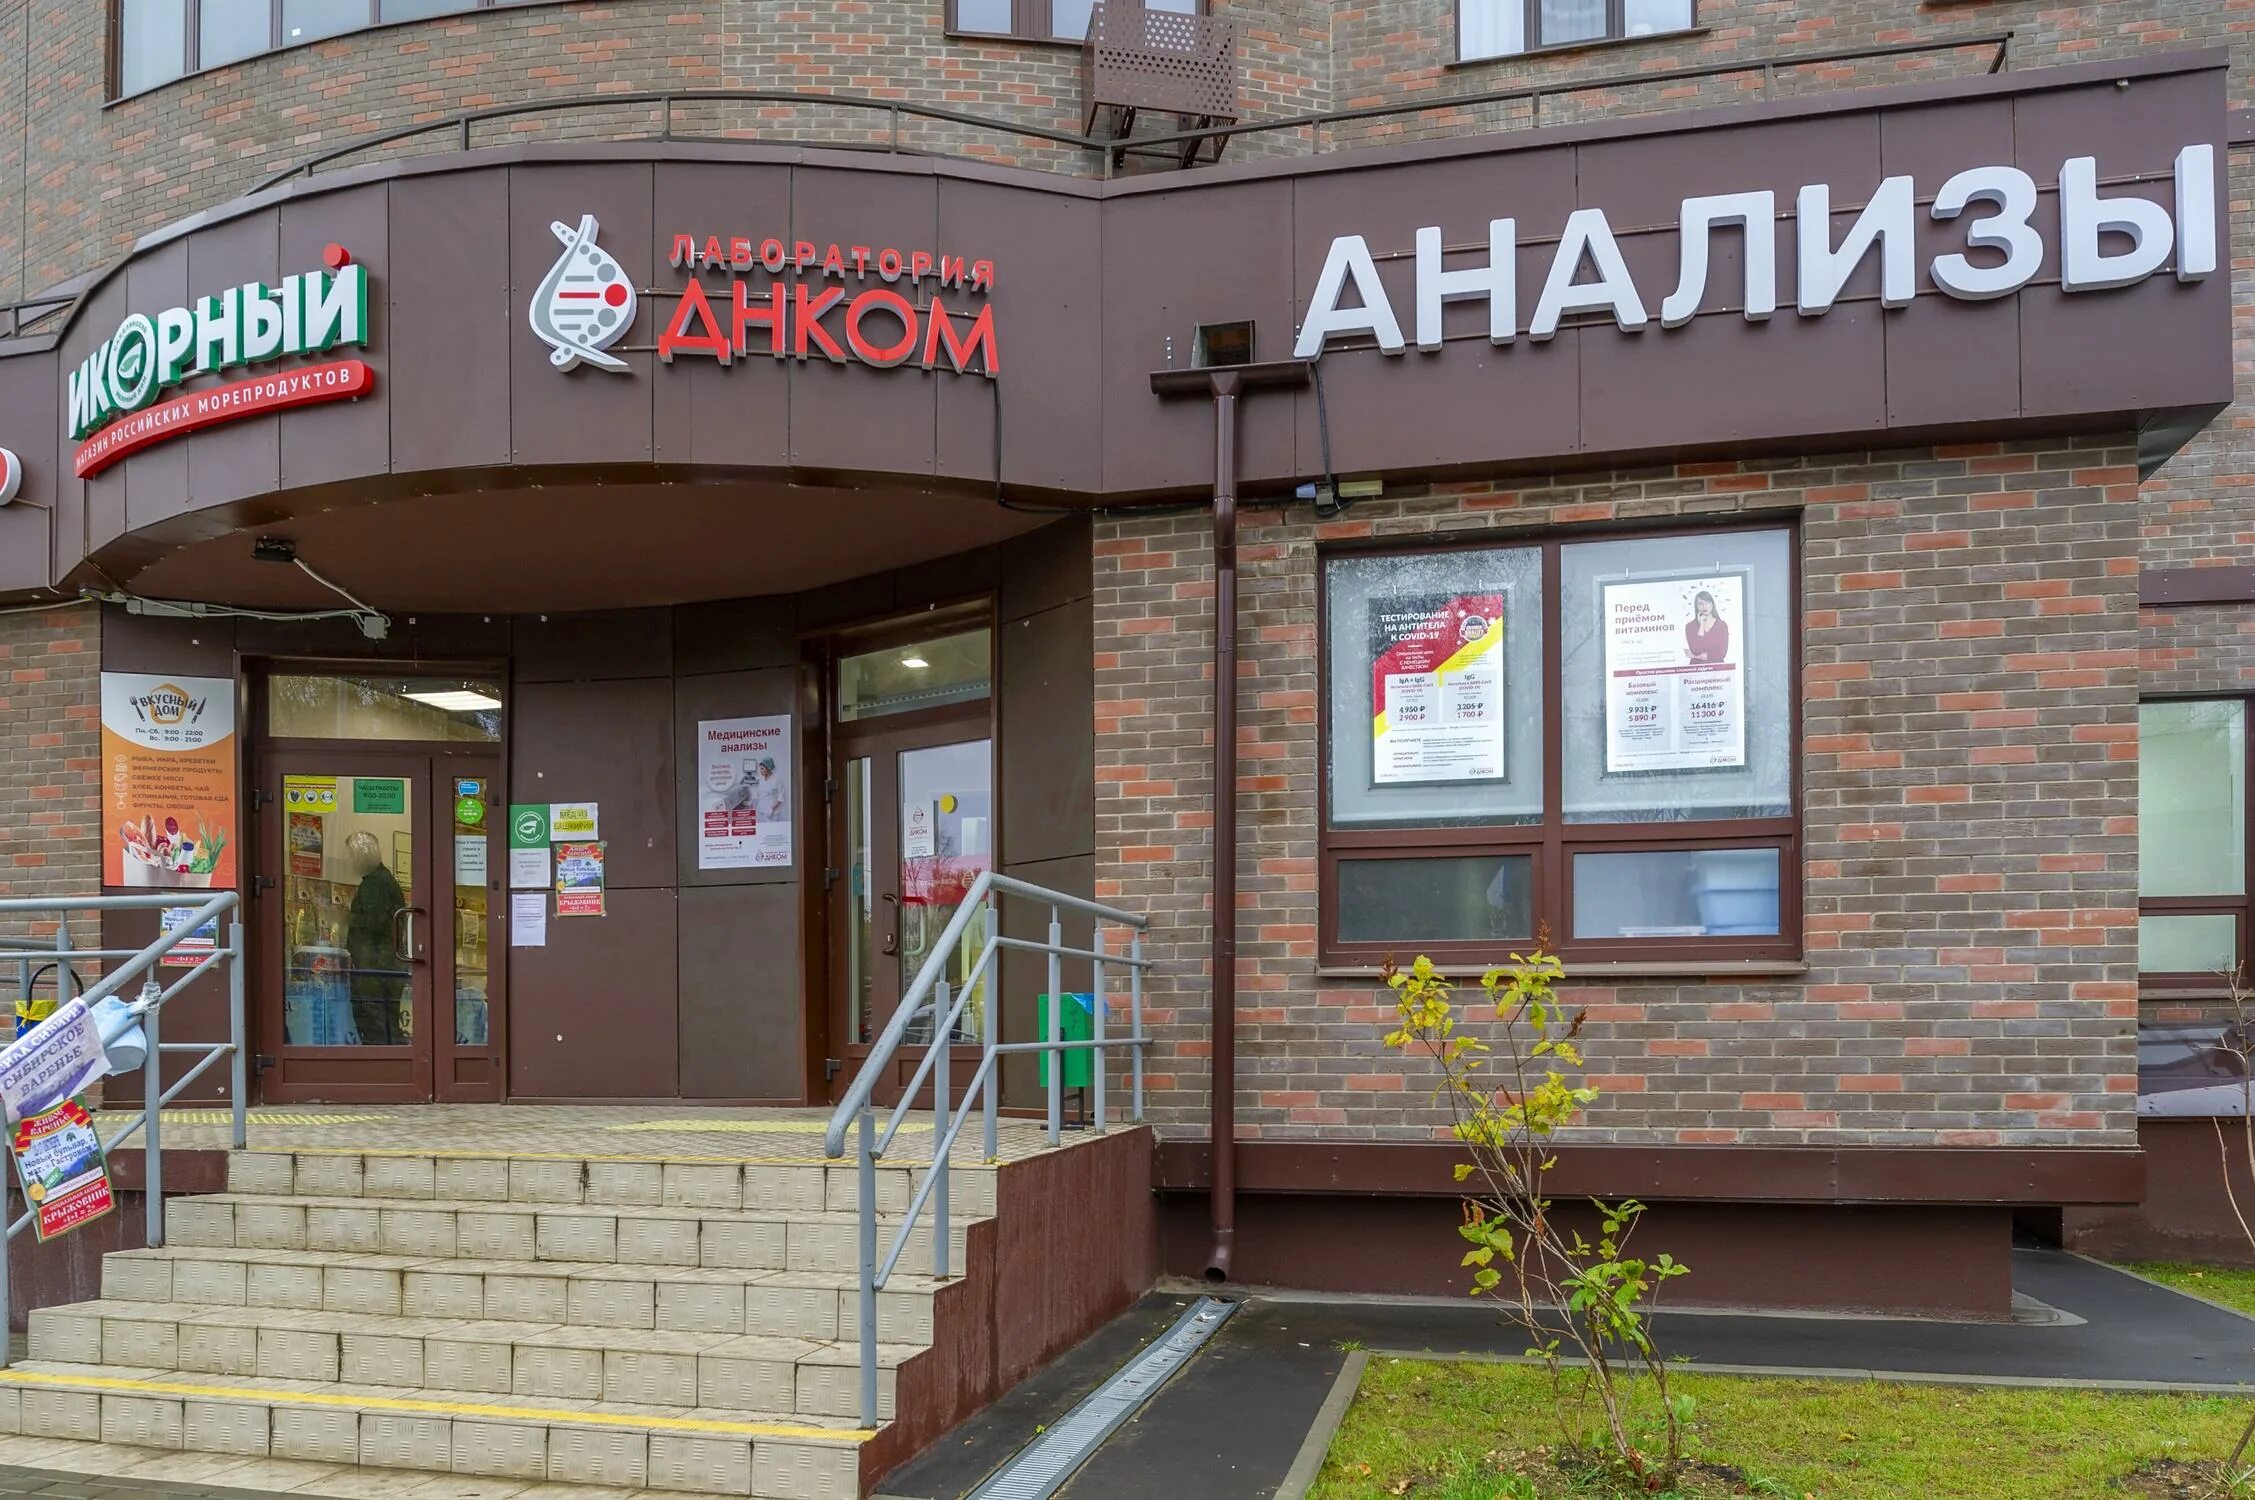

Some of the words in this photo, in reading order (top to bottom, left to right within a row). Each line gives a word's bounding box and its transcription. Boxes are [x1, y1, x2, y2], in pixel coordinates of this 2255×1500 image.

[1293, 143, 2216, 363] АНАЛИЗЫ
[669, 234, 994, 293] ЛАБОРАТОРИЯ
[658, 278, 999, 378] ДНКОМ
[68, 243, 367, 440] ИКОРНЫЙ
[75, 440, 108, 468] МАГАЗИН
[111, 403, 190, 446] РОССИЙСКИХ
[198, 368, 350, 414] МОРЕПРОДУКТОВ
[1380, 610, 1449, 622] ТЕСТИРОВАНИЕ
[1615, 603, 1650, 614] Перед
[1384, 624, 1398, 632] НА
[1399, 621, 1446, 631] АНТИТЕЛА
[1615, 614, 1665, 626] приёмом
[1398, 631, 1440, 641] COVID-19
[1615, 625, 1675, 635] витаминов
[1464, 673, 1475, 681] IgG
[139, 694, 198, 711] ВКУСНЫЙ
[154, 705, 179, 717] ДОМ
[708, 726, 781, 741] Медицинские
[720, 742, 768, 753] анализы
[4, 1022, 85, 1091] СИБИРСКОЕ
[20, 1045, 83, 1097] ВАРЕНЬЕ
[30, 1112, 71, 1136] ВАРЕНЬЕ
[24, 1151, 53, 1169] Новый
[88, 1133, 95, 1142] 2
[27, 1164, 46, 1178] маг.
[43, 1186, 110, 1225] КРЫЖОВНИК
